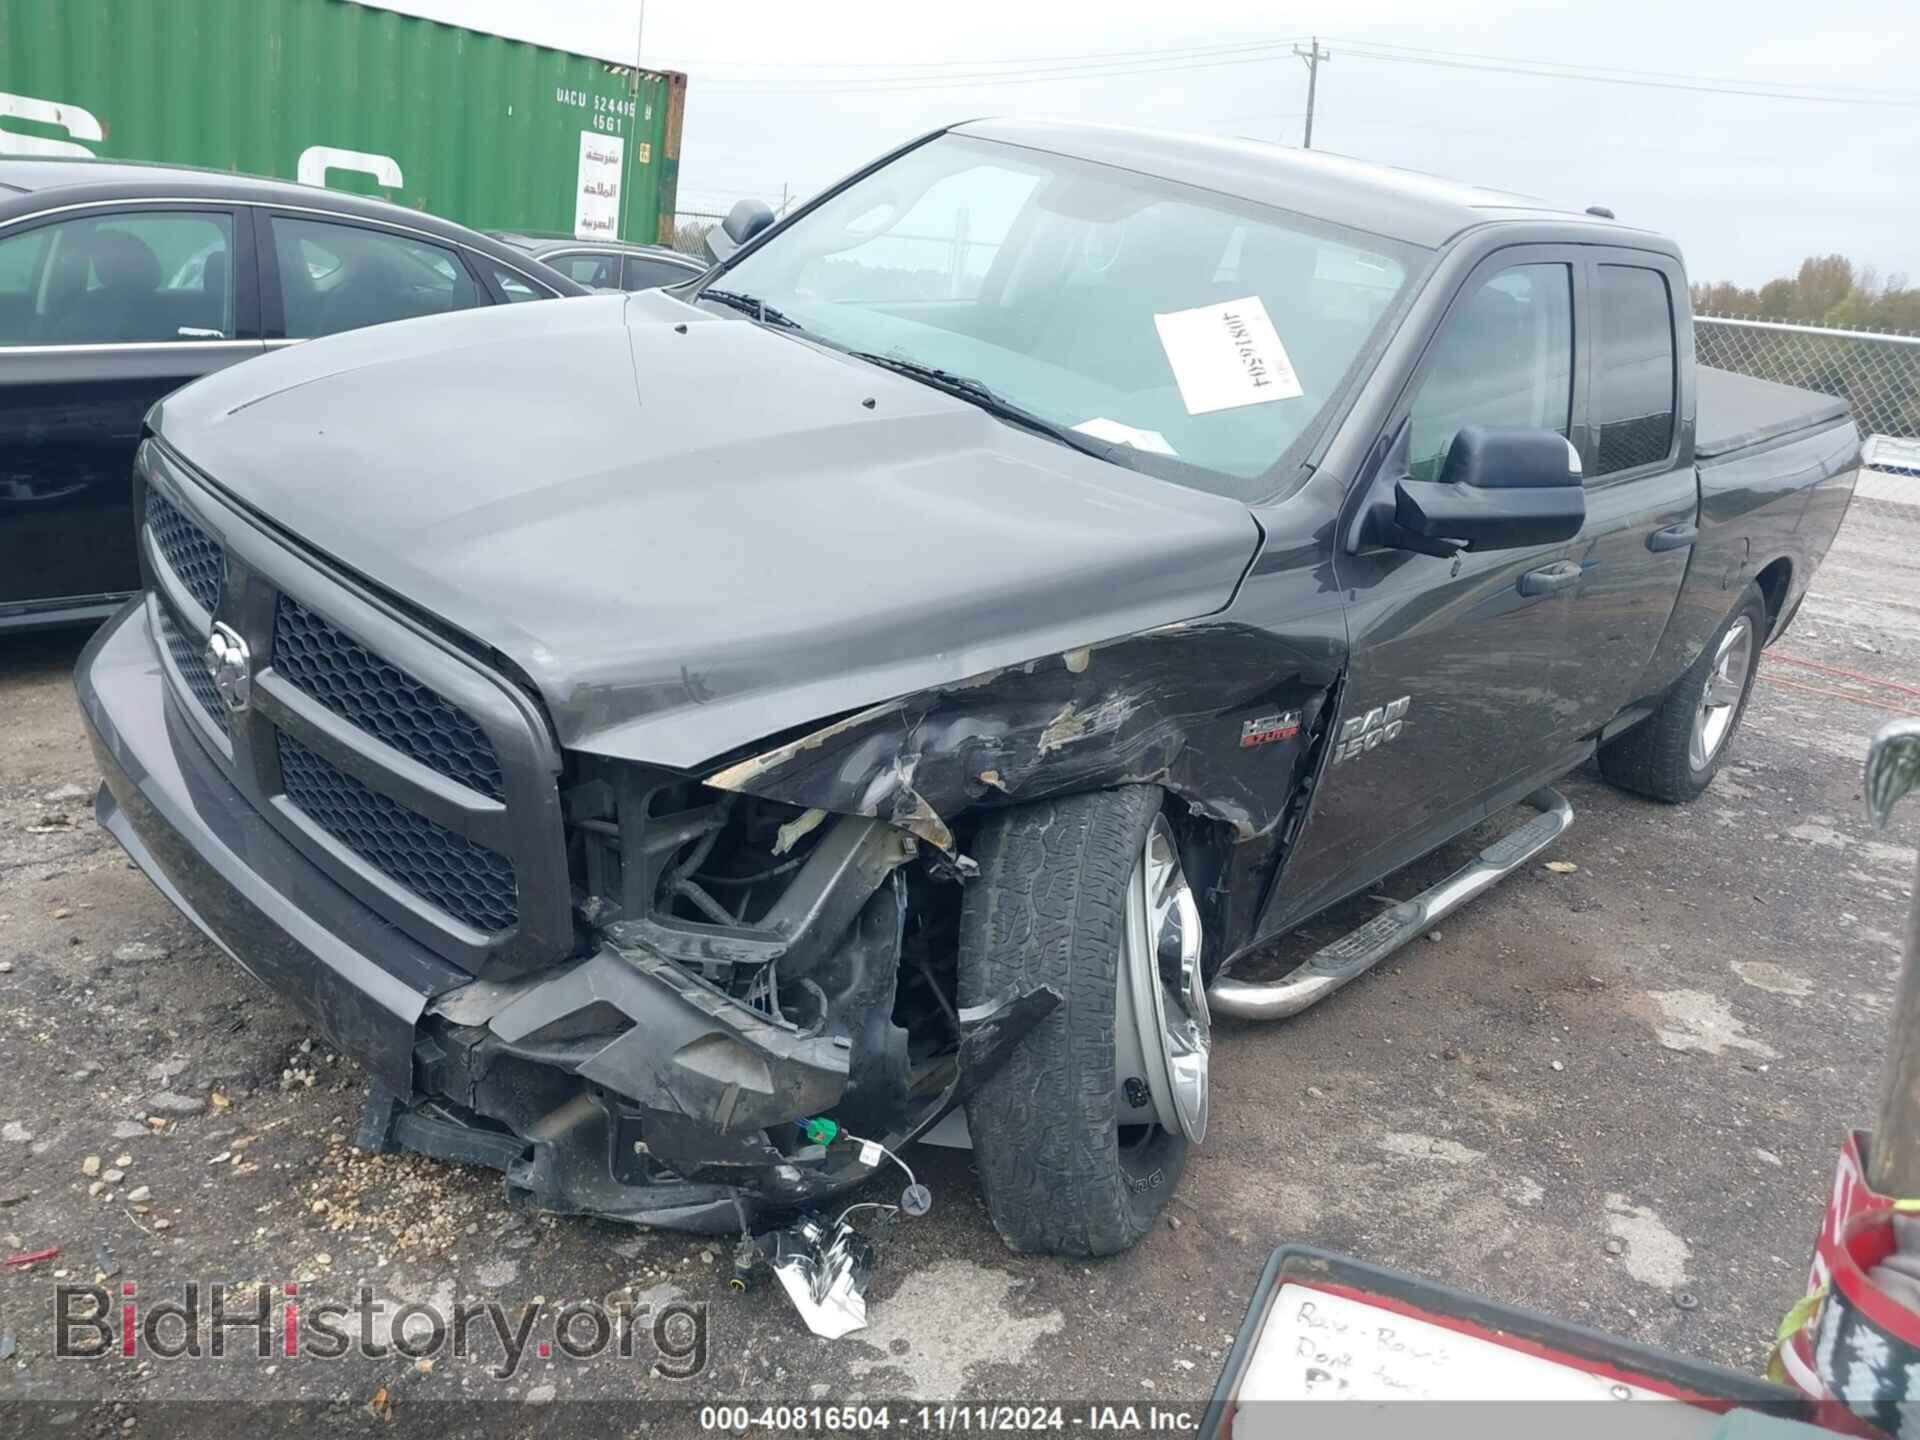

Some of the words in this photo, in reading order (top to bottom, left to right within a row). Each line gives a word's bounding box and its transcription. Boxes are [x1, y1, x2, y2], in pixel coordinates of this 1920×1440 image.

[556, 87, 587, 106] UACU
[1222, 312, 1272, 388] 40816504
[1332, 719, 1403, 765] 1500
[1338, 695, 1411, 743] RAM
